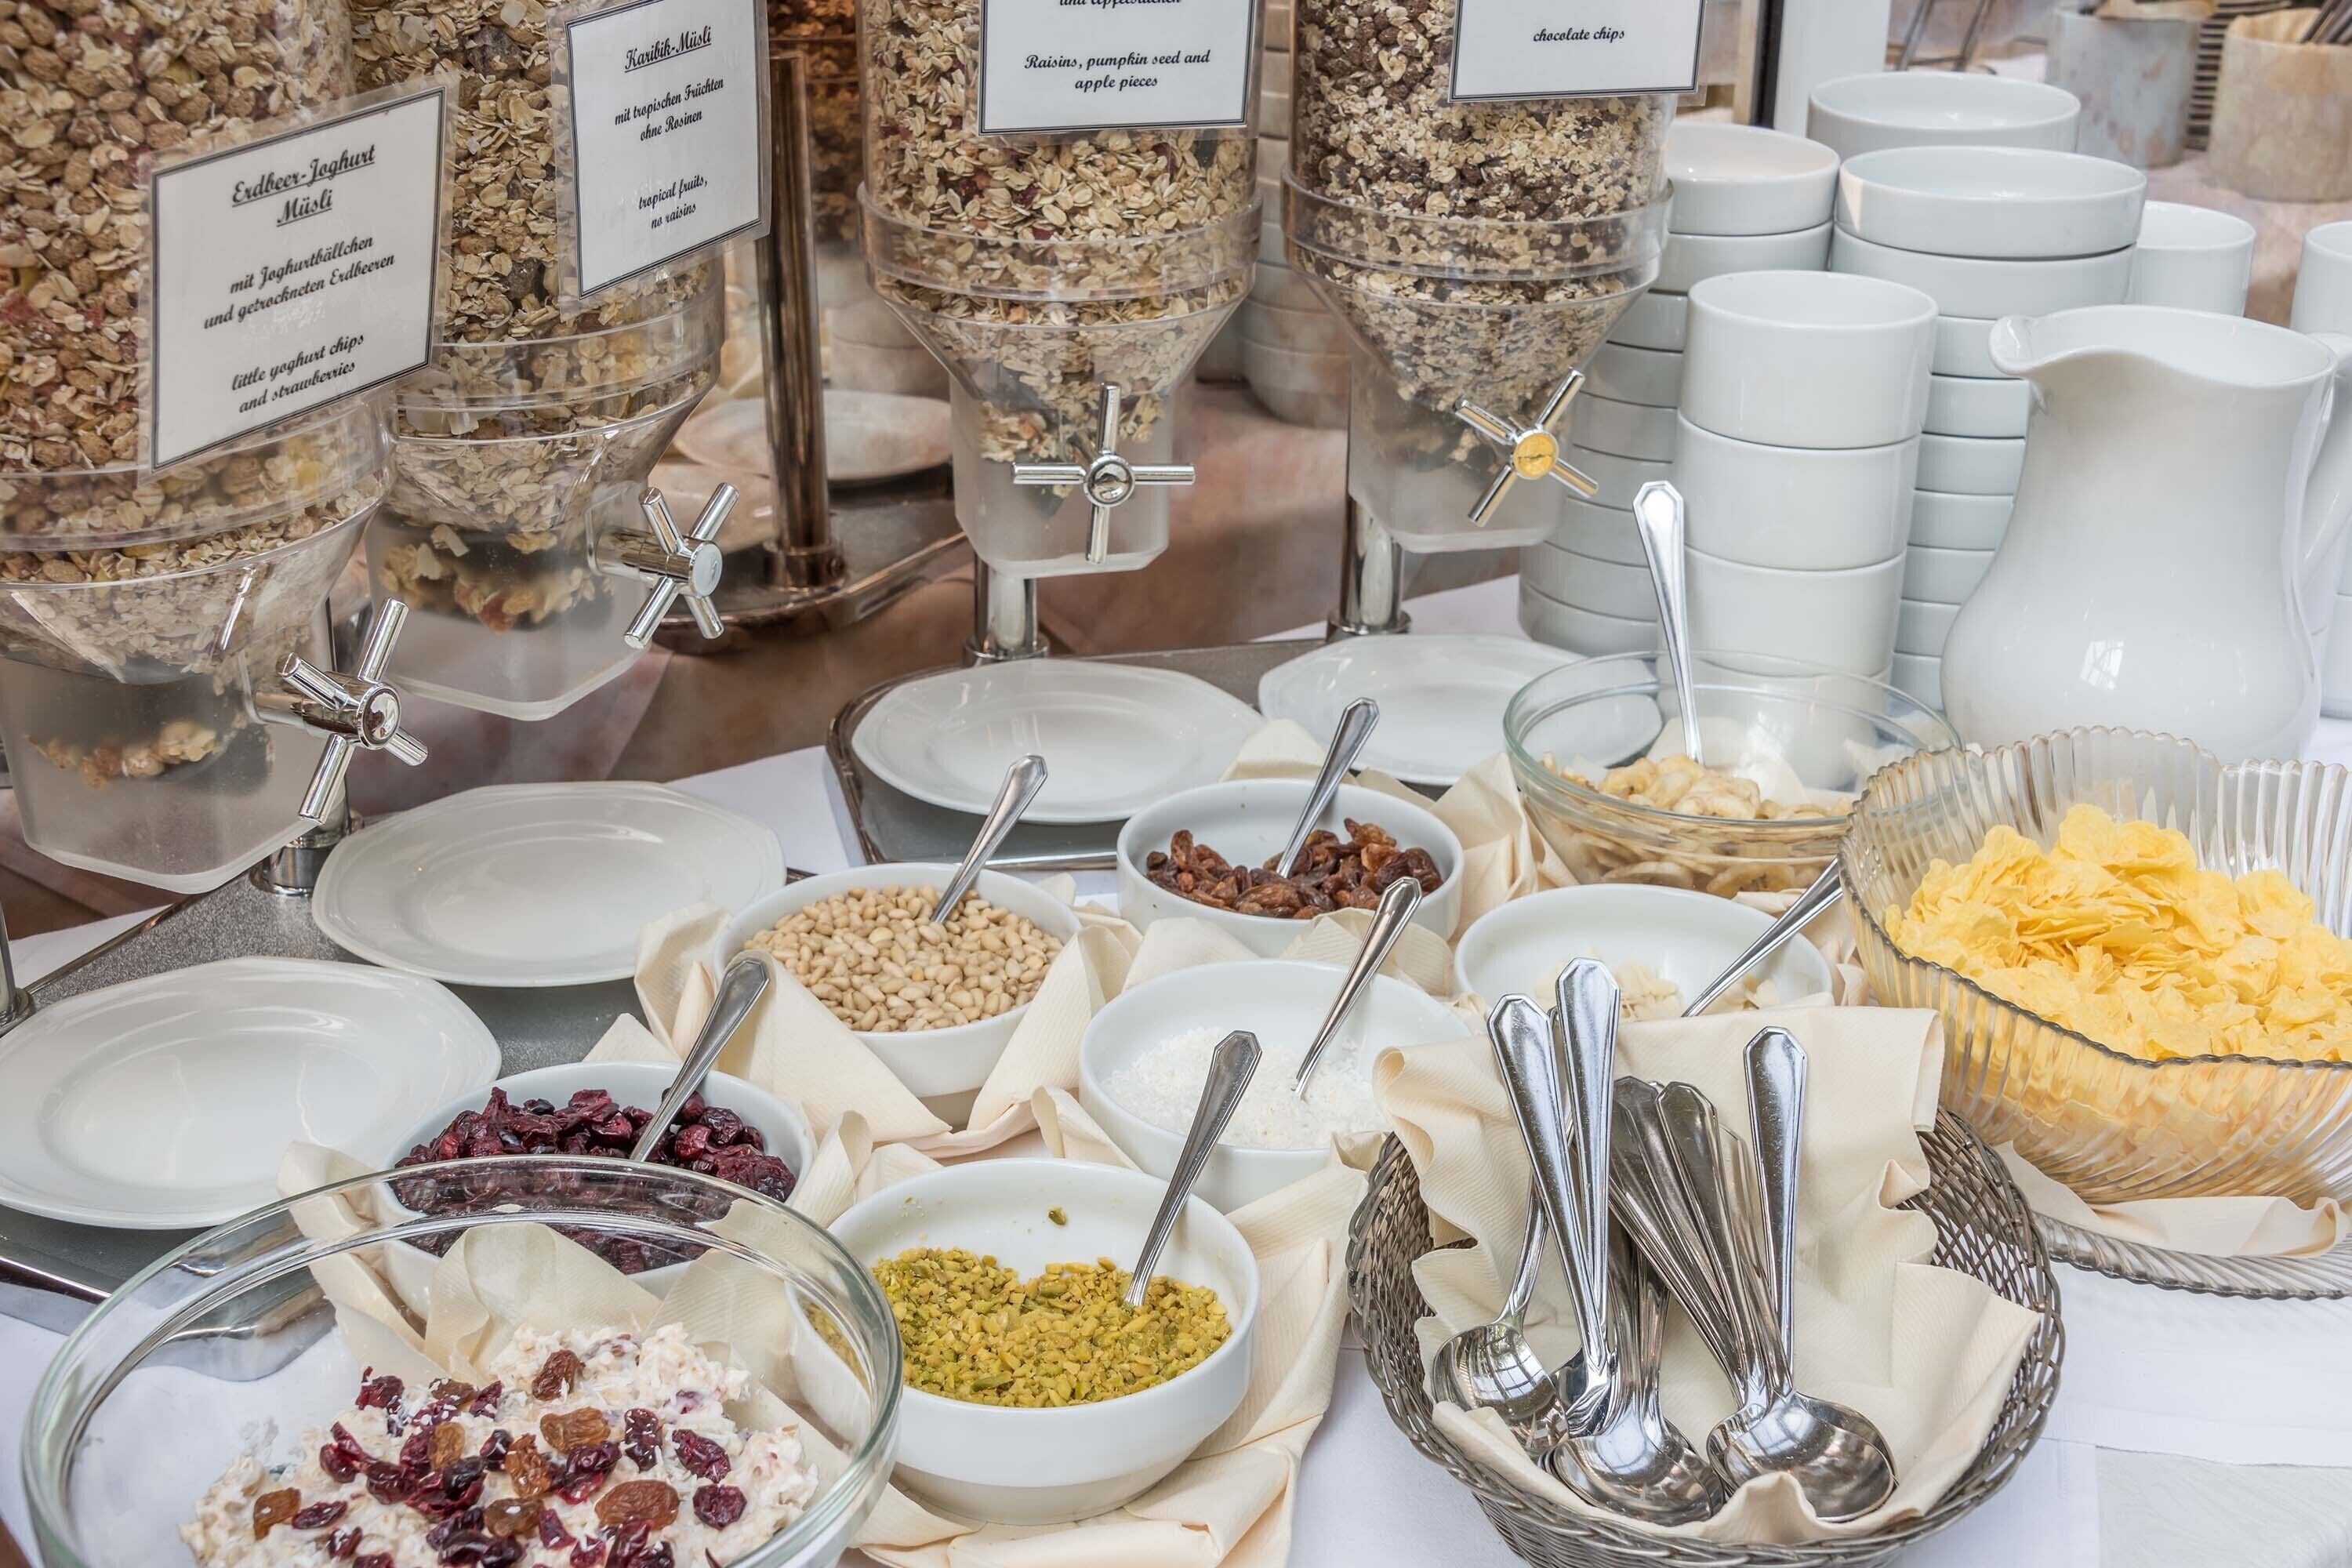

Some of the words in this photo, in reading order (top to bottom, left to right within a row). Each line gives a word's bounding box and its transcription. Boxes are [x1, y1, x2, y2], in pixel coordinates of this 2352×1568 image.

[624, 25, 712, 73] Karibik-Müsli
[1533, 27, 1590, 42] chocolate
[1593, 27, 1625, 43] chips
[1024, 54, 1083, 70] Raisins,
[1086, 52, 1148, 71] pumpkin
[1152, 50, 1181, 65] seed
[1184, 49, 1210, 64] and
[615, 107, 631, 125] mit
[633, 93, 682, 119] tropischen
[684, 78, 724, 102] Früchten
[1075, 74, 1116, 93] apple
[1119, 77, 1158, 92] pieces
[640, 124, 662, 141] ohne
[665, 110, 703, 132] Rosinen
[231, 144, 376, 208] Erdbeer-Joghurt
[638, 182, 677, 209] tropical
[678, 175, 708, 199] fruits,
[276, 189, 333, 227] Müsli
[651, 217, 663, 229] no
[664, 203, 697, 223] raisins
[230, 274, 255, 296] mit
[258, 236, 374, 289] Joghurtbällchen
[204, 305, 234, 330] und
[238, 278, 325, 323] getrockneten
[328, 252, 396, 287] Erdbeeren
[231, 365, 267, 391] little
[269, 346, 327, 382] yoghurt
[328, 332, 365, 357] chips
[238, 390, 269, 414] and
[271, 361, 356, 403] strawberries
